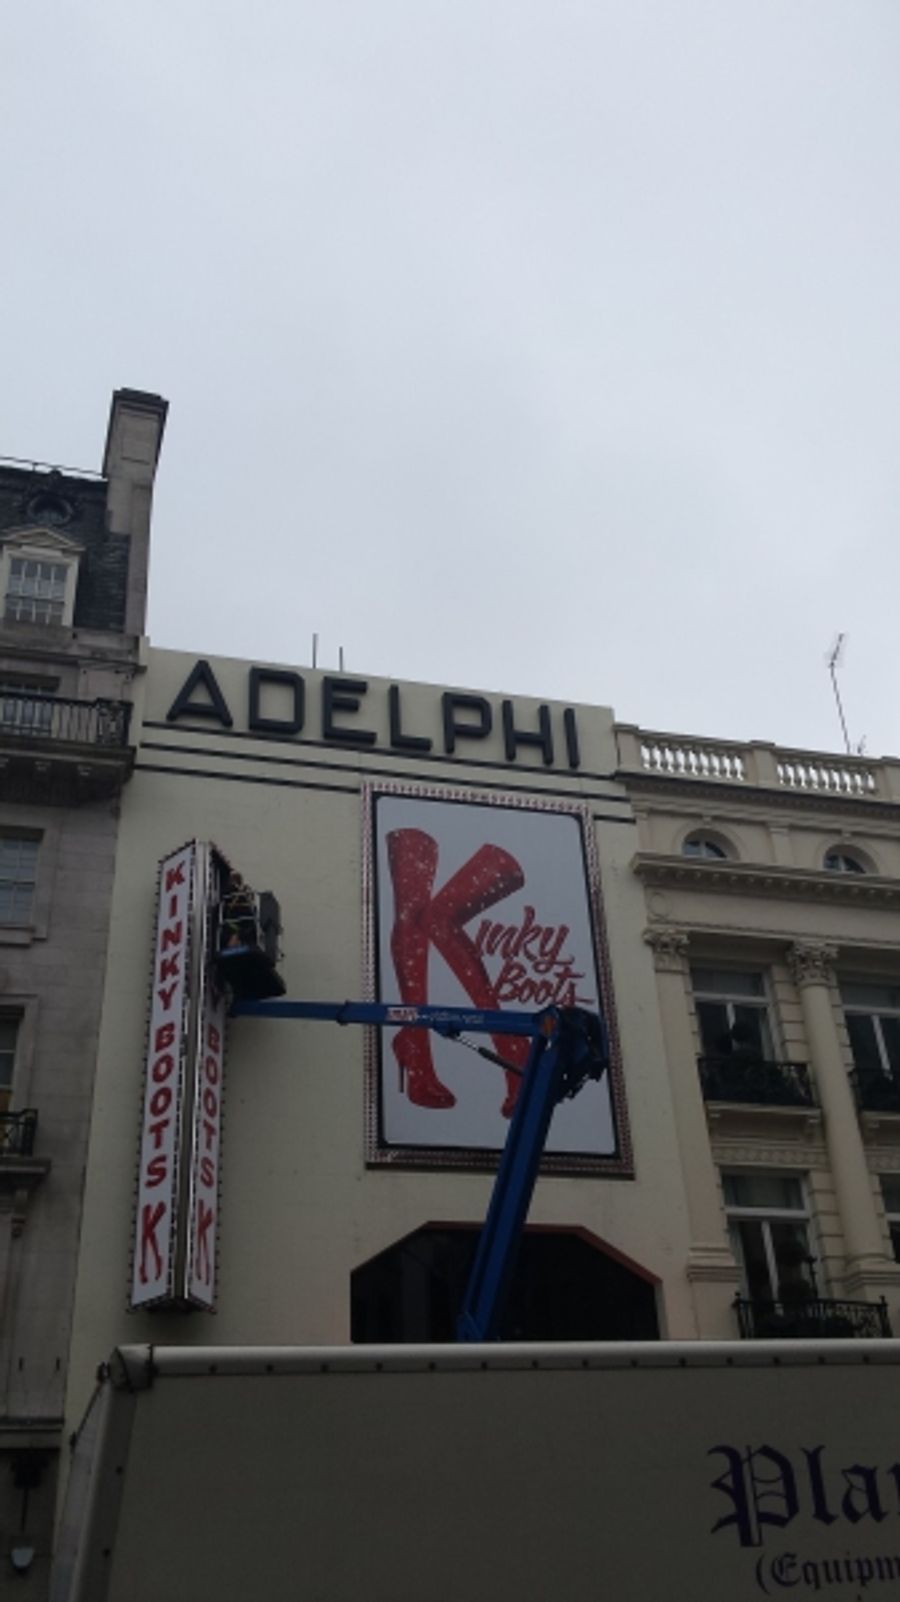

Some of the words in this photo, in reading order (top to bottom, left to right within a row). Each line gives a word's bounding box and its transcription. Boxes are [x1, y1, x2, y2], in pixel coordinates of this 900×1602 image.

[166, 659, 580, 769] ADELPHI
[158, 860, 185, 1010] KINKY
[493, 960, 594, 1008] Boots
[145, 1022, 175, 1188] BOOTS
[199, 1023, 221, 1189] BOOTS
